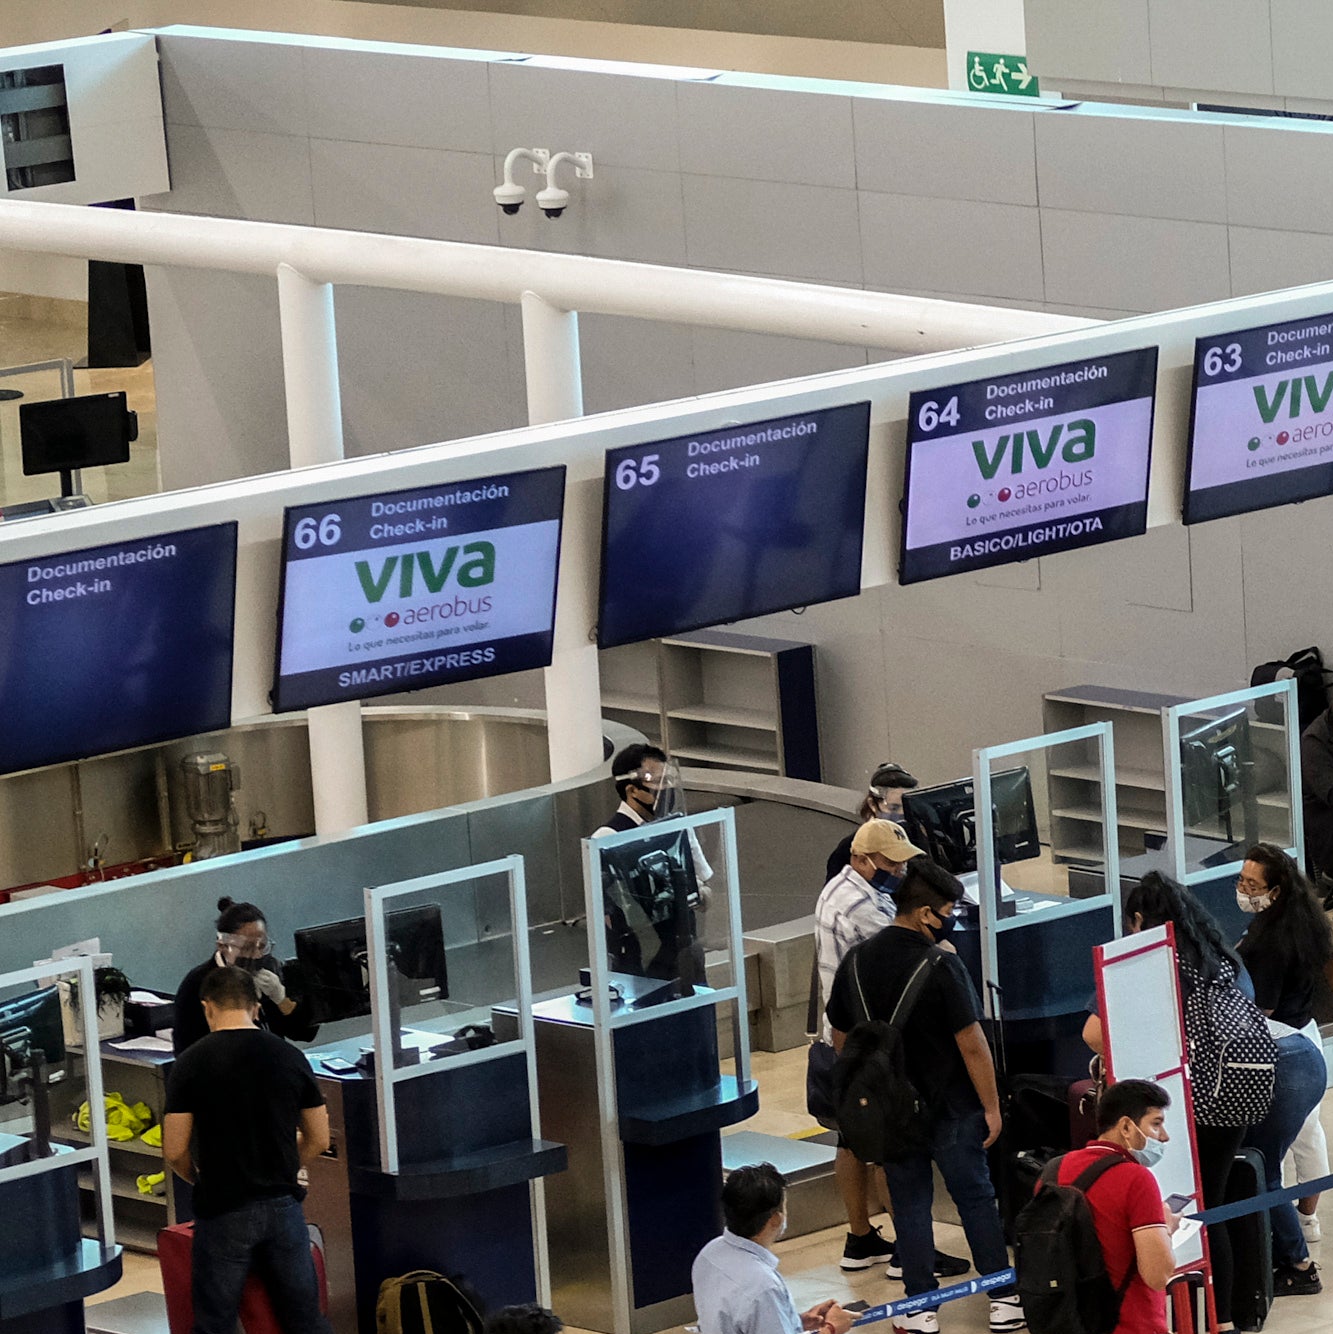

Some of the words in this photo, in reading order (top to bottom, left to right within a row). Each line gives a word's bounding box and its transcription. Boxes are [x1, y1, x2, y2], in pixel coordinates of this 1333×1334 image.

[1203, 343, 1242, 377] 63
[1265, 343, 1330, 366] Check-in
[918, 396, 960, 432] 64
[986, 364, 1108, 400] Documentación
[985, 396, 1054, 420] Check-in
[615, 454, 660, 490] 65
[688, 421, 817, 457] Documentación
[687, 453, 760, 479] Check-in
[1014, 469, 1093, 500] aerobus
[294, 513, 341, 550] 66
[371, 484, 509, 518] Documentación
[370, 516, 447, 540] Check-in
[979, 512, 997, 526] que
[999, 503, 1042, 521] necesitas
[1044, 499, 1066, 513] para
[949, 517, 1103, 561] BASICO/LIGHT/OTA
[28, 544, 177, 582] Documentación
[27, 578, 112, 605] Check-in
[403, 595, 492, 626] aerobus
[338, 647, 495, 688] SMART/EXPRESS
